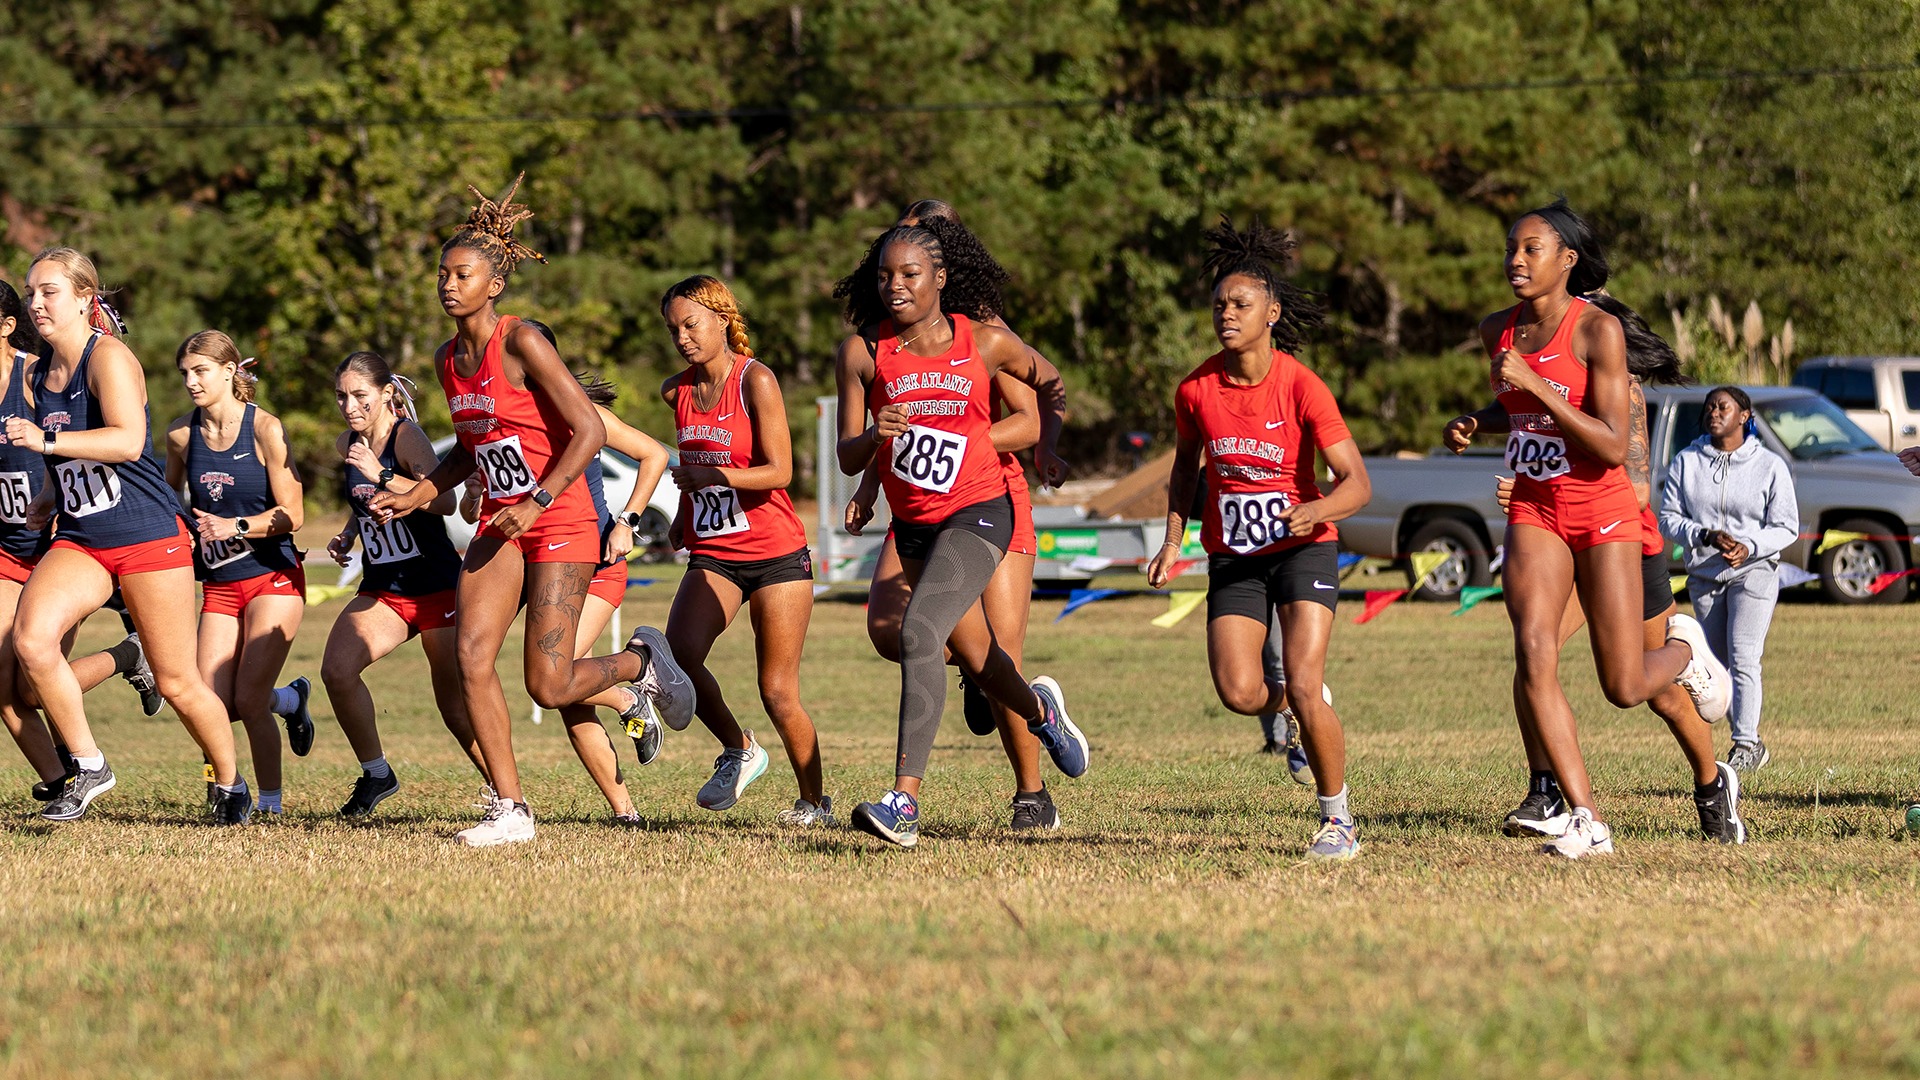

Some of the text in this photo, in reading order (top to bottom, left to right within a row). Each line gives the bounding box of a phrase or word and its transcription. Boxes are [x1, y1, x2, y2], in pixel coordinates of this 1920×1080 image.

[463, 393, 495, 414] ATLANTA
[885, 372, 972, 399] CLARK ATLANTA
[893, 400, 968, 416] IVERSITY
[696, 425, 732, 447] ATLANTA
[1238, 438, 1285, 464] ATLANTA
[895, 429, 959, 486] 285
[0, 477, 27, 519] 05
[63, 464, 114, 513] 311
[693, 490, 736, 531] 287
[1225, 498, 1290, 546] 288
[364, 518, 413, 559] 310
